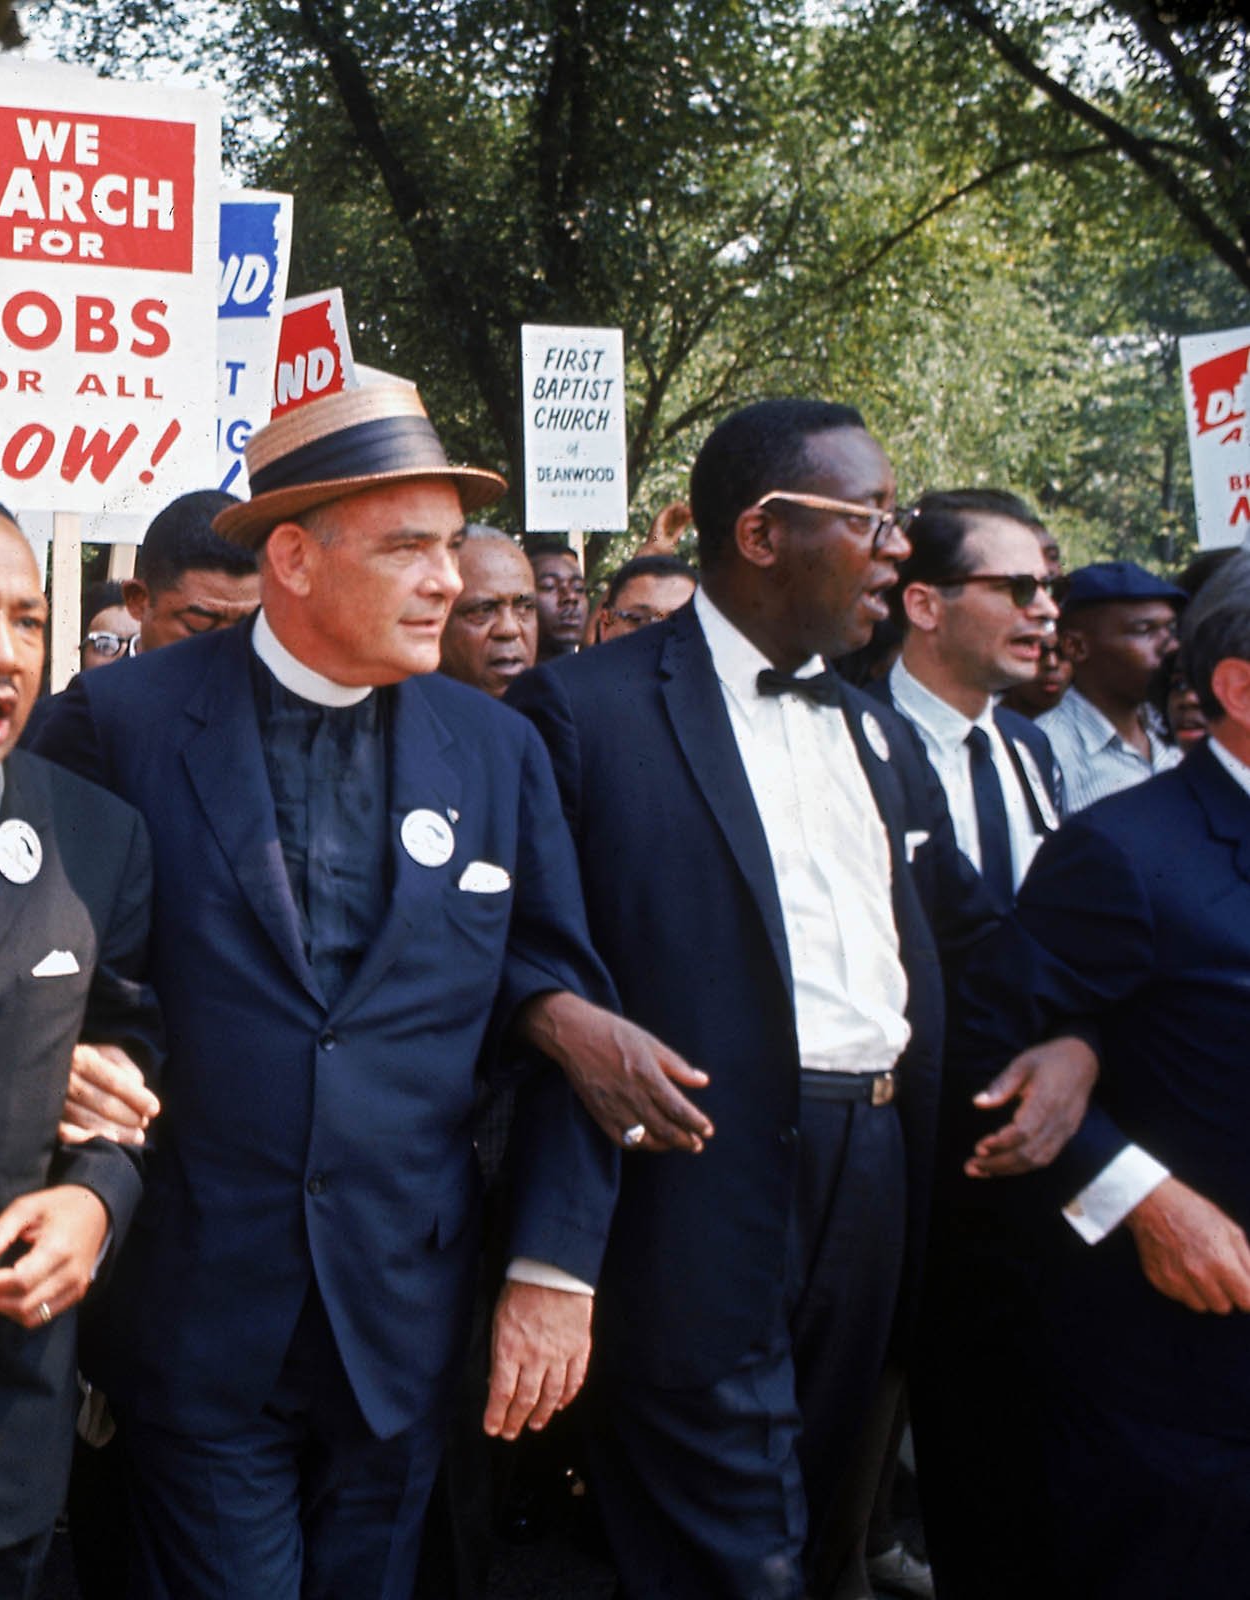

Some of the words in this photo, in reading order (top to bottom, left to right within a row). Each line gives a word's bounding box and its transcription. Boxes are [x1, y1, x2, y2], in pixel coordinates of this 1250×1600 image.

[17, 117, 99, 166] WE
[13, 226, 104, 258] FOR
[543, 348, 605, 372] FIRST
[76, 373, 163, 399] ALL
[533, 377, 614, 401] BAPTIST
[534, 407, 610, 431] CHURCH
[537, 467, 614, 482] DEANWOOD
